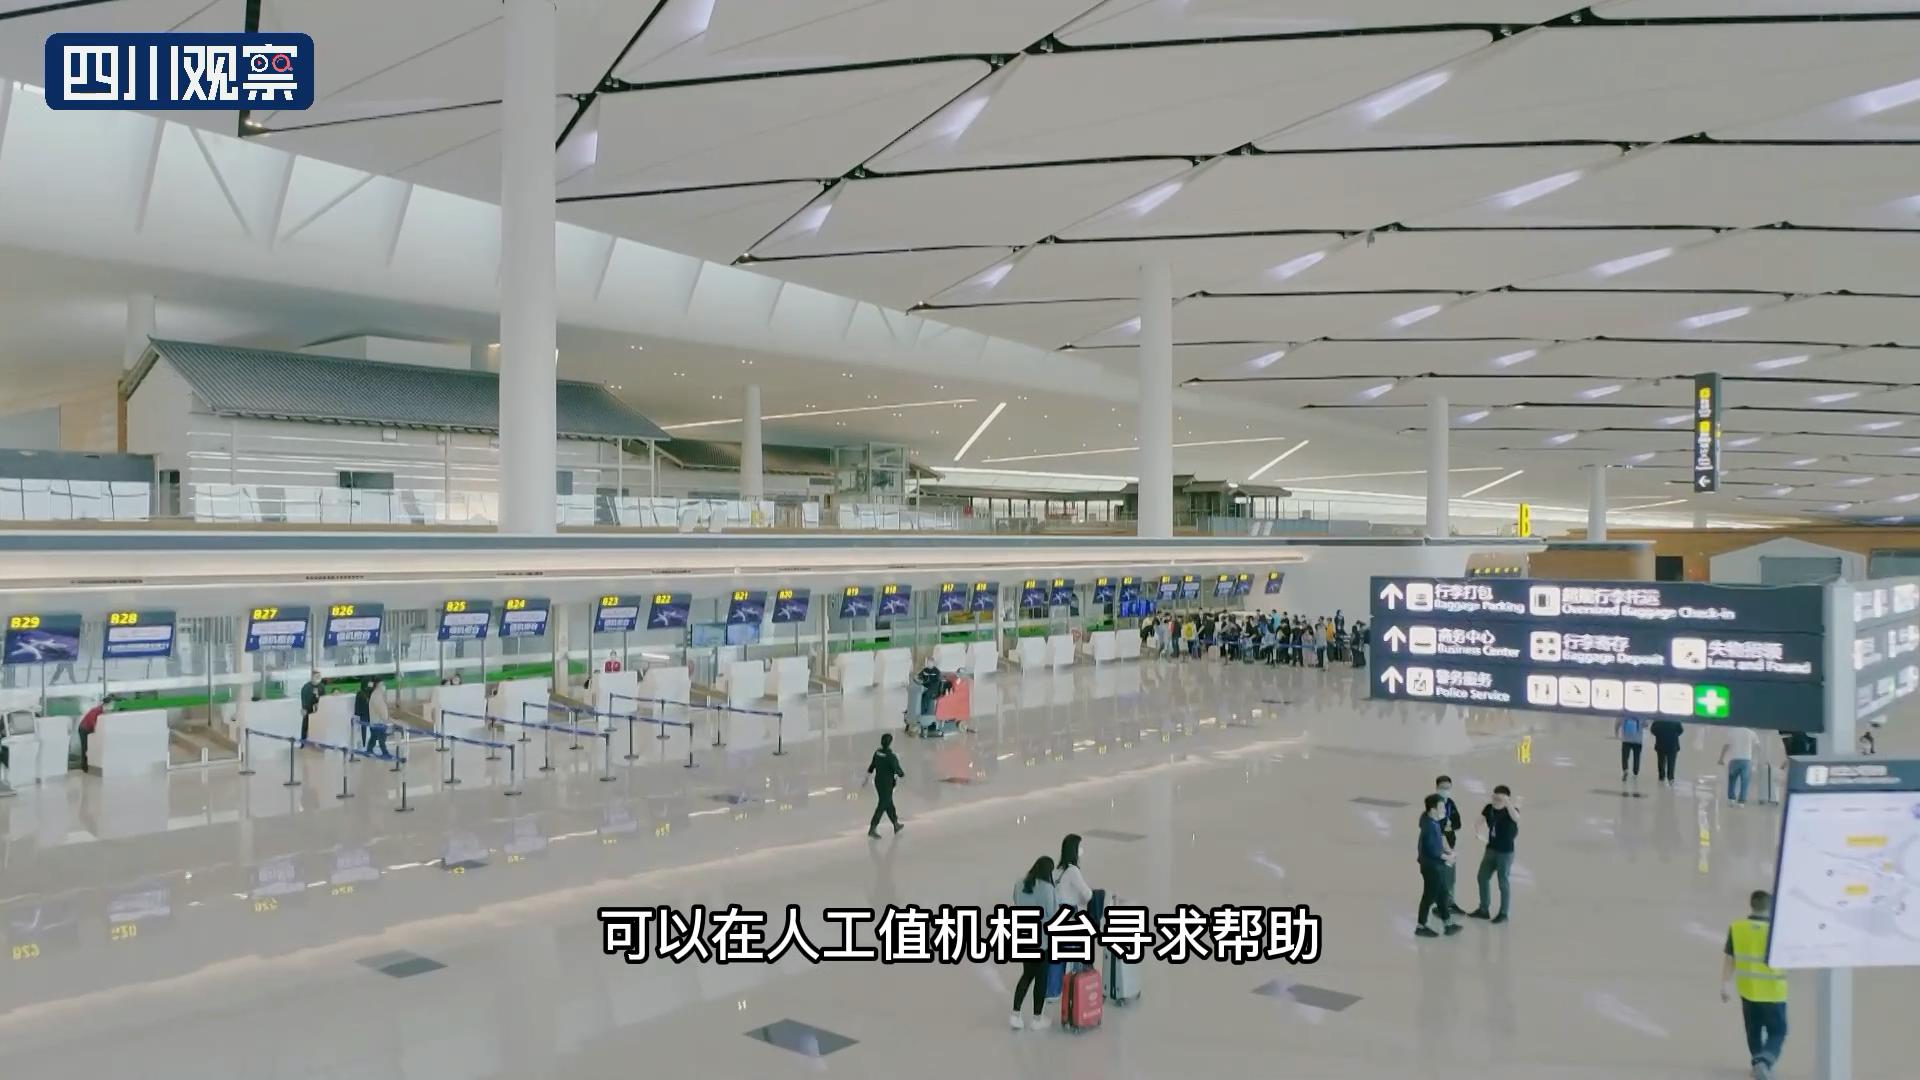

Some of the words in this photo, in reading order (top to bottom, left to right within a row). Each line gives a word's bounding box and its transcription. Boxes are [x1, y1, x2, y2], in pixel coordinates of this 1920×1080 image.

[654, 593, 672, 605] B22
[1434, 584, 1494, 601] 行李打包
[1562, 587, 1661, 607] 行李托运
[445, 600, 467, 613] B25
[506, 598, 526, 610] B24
[601, 596, 618, 607] B23
[252, 607, 278, 621] B27
[331, 604, 354, 617] B26
[10, 615, 41, 630] B29
[108, 611, 138, 626] B28
[1438, 643, 1482, 656] Business
[1483, 645, 1521, 658] Center
[1435, 686, 1469, 699] Police
[1470, 689, 1511, 703] Service
